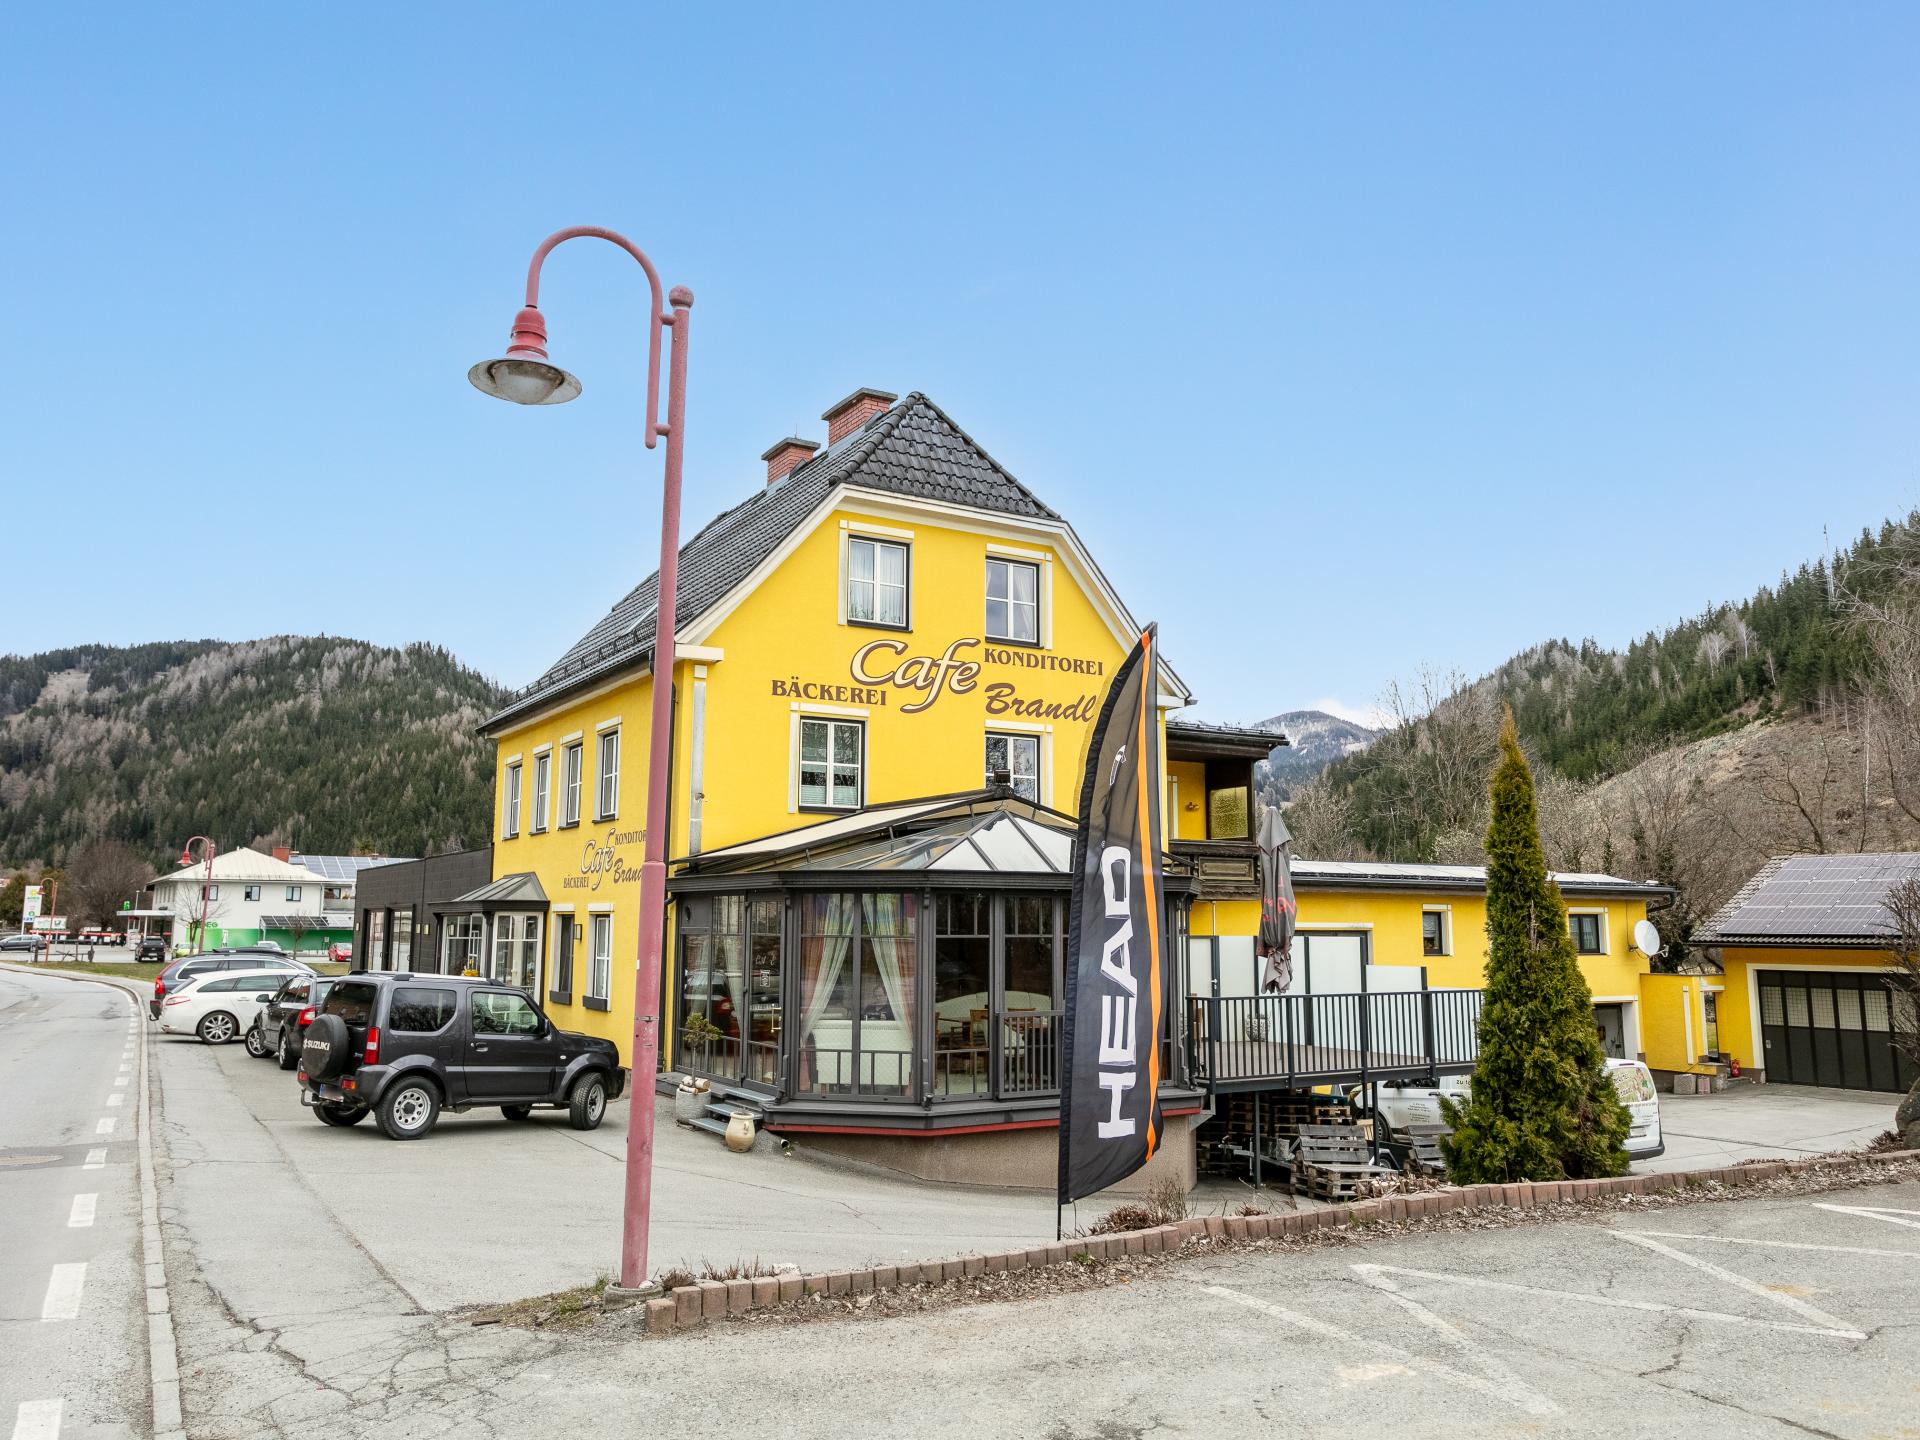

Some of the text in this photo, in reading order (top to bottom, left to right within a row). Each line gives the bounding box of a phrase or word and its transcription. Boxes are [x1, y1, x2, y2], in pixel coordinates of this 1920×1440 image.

[850, 638, 981, 713] Cafe
[984, 648, 1104, 676] KONDITOREI
[771, 676, 887, 705] BÄCKEREI
[984, 682, 1098, 723] Brandl
[580, 828, 616, 891] Cafe
[1098, 845, 1137, 1139] HEAD
[307, 1039, 330, 1051] SUZUKI
